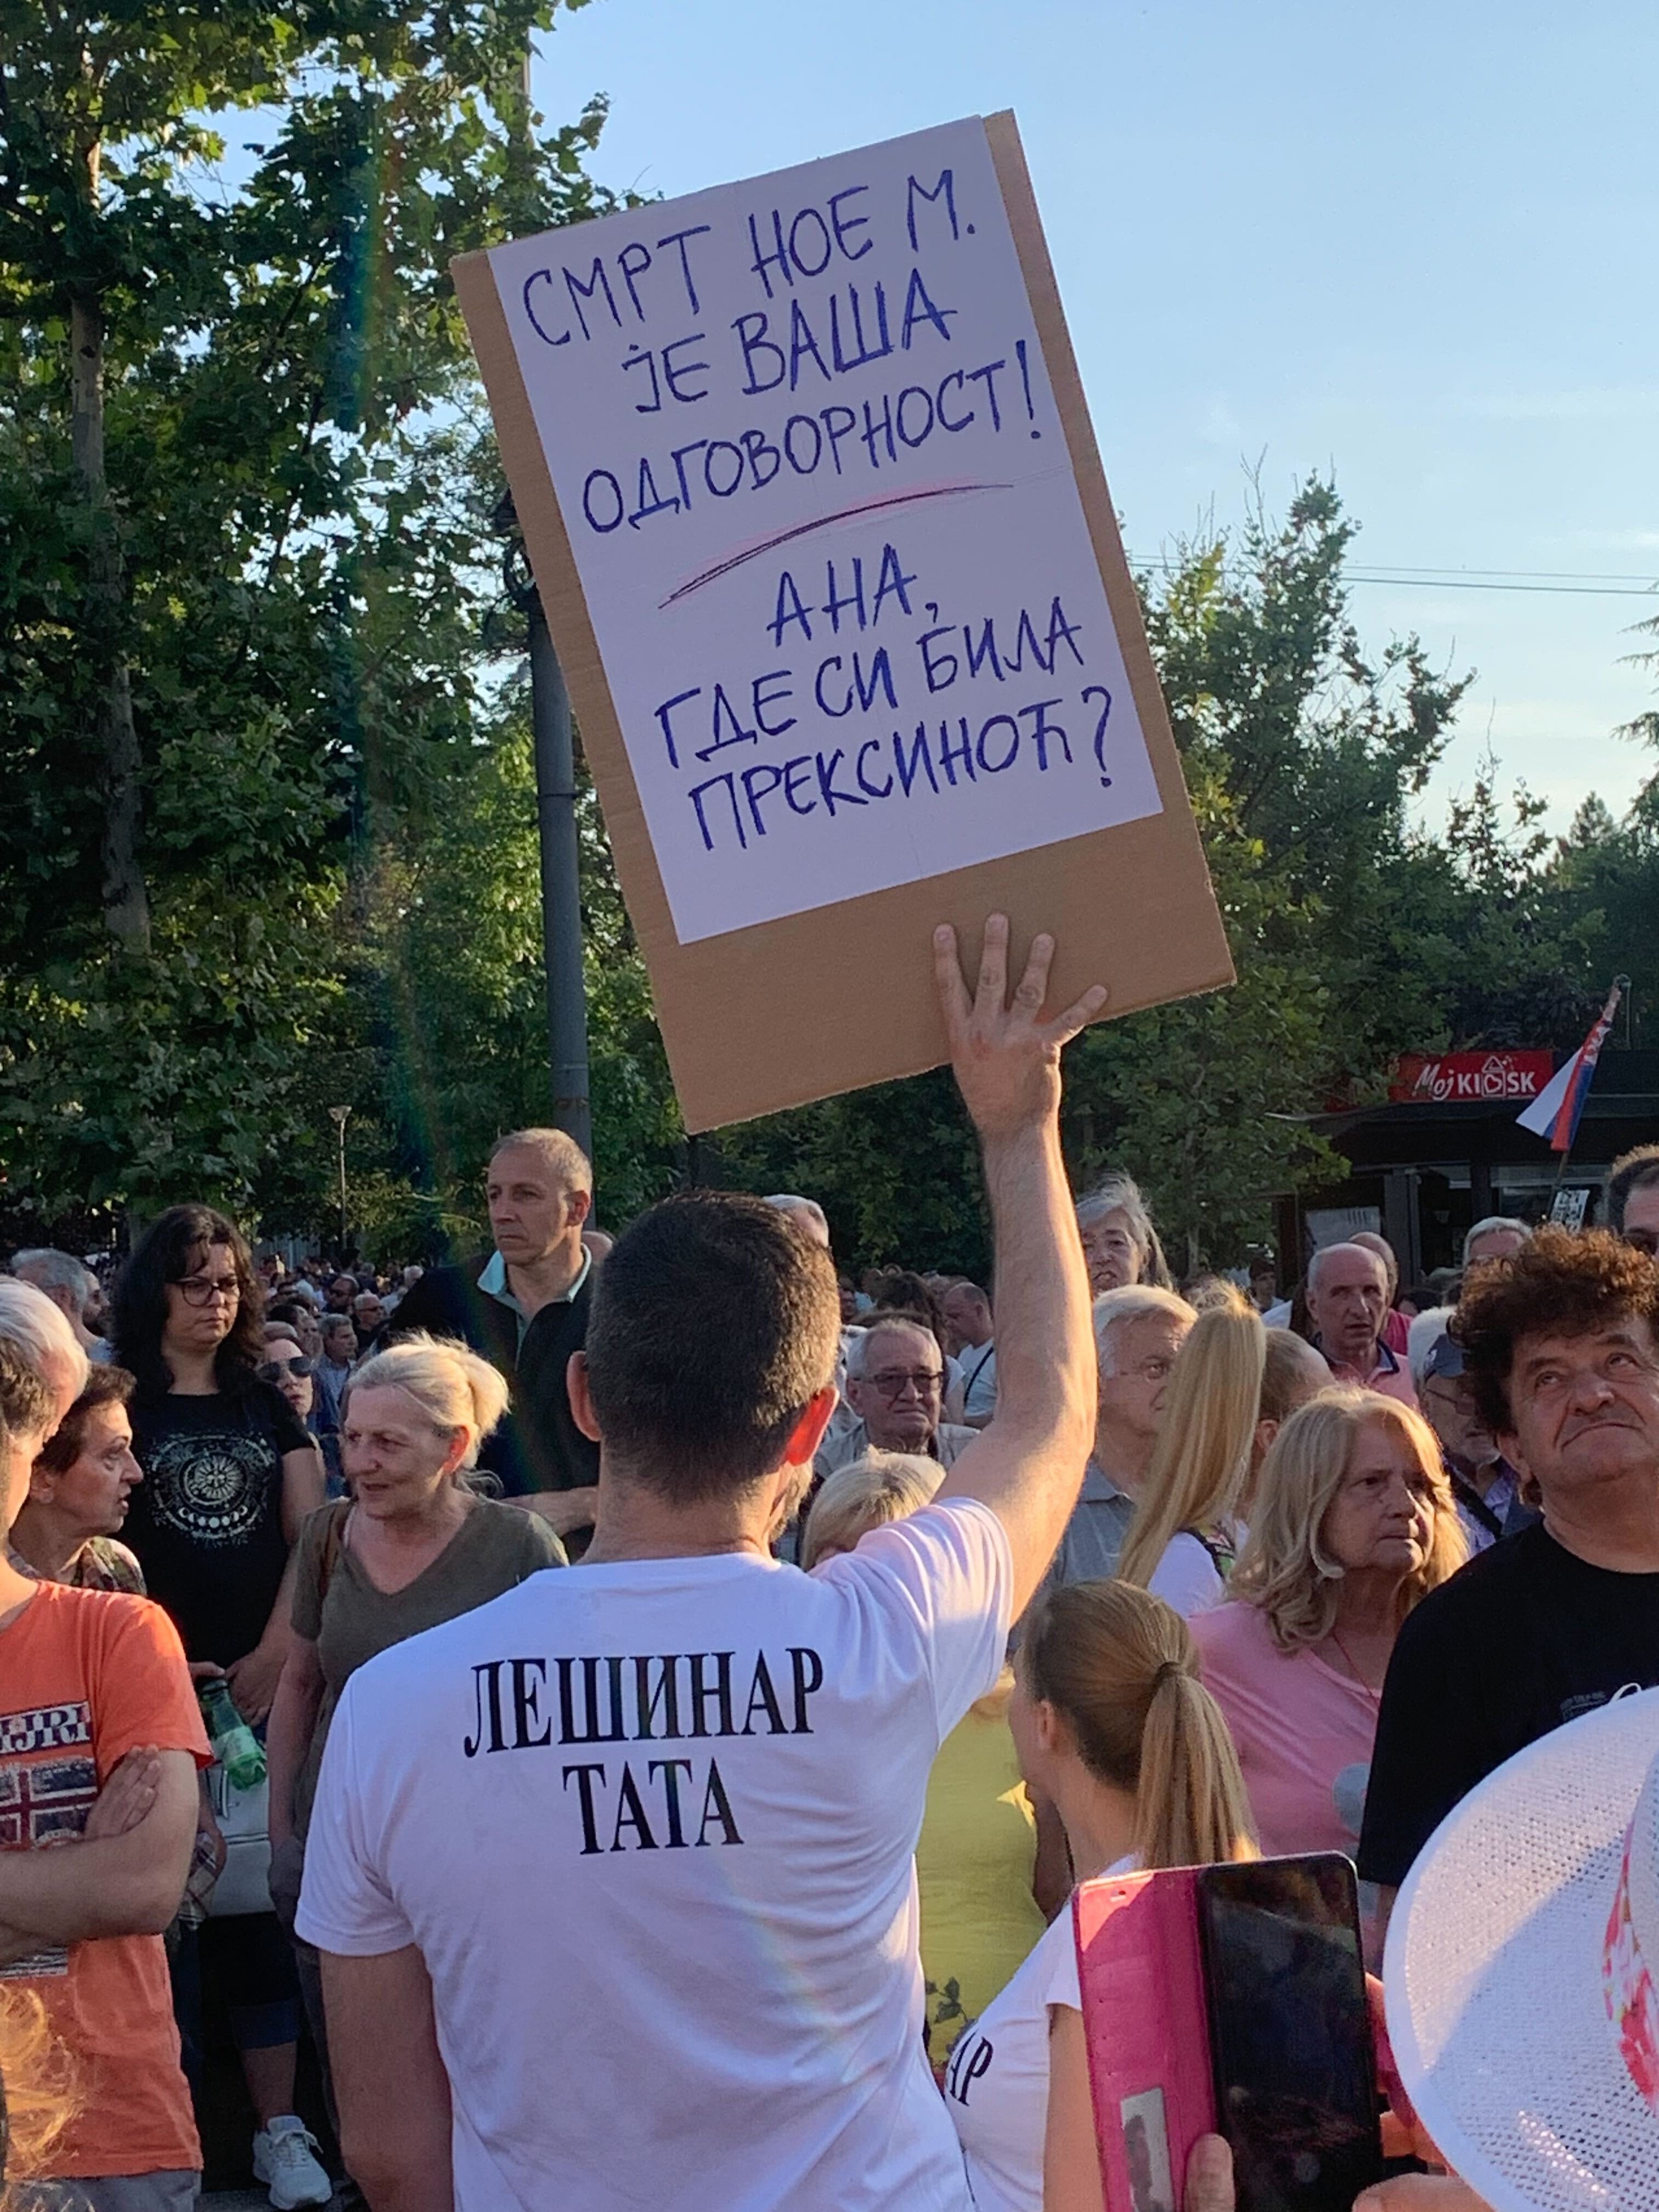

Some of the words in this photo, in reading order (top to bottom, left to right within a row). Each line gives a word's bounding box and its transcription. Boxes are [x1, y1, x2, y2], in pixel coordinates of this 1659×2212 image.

[523, 224, 712, 346] СМРТ
[748, 185, 873, 299] НОЕ
[906, 168, 976, 253] М.
[730, 267, 958, 396] ВАША
[582, 338, 1042, 533] ОДГОВОРНОСТ!
[766, 542, 939, 648] АНА,
[653, 670, 798, 769] ГДЕ
[814, 646, 899, 718] СИ
[915, 596, 1085, 694] БИЛА
[687, 686, 1113, 851] ПРЕКСИНОЋ?
[1412, 1063, 1454, 1101] Moj
[1457, 1067, 1537, 1097] KIOSK
[463, 1647, 824, 1758] ЛЕШИНАР
[561, 1757, 745, 1855] ТАТА
